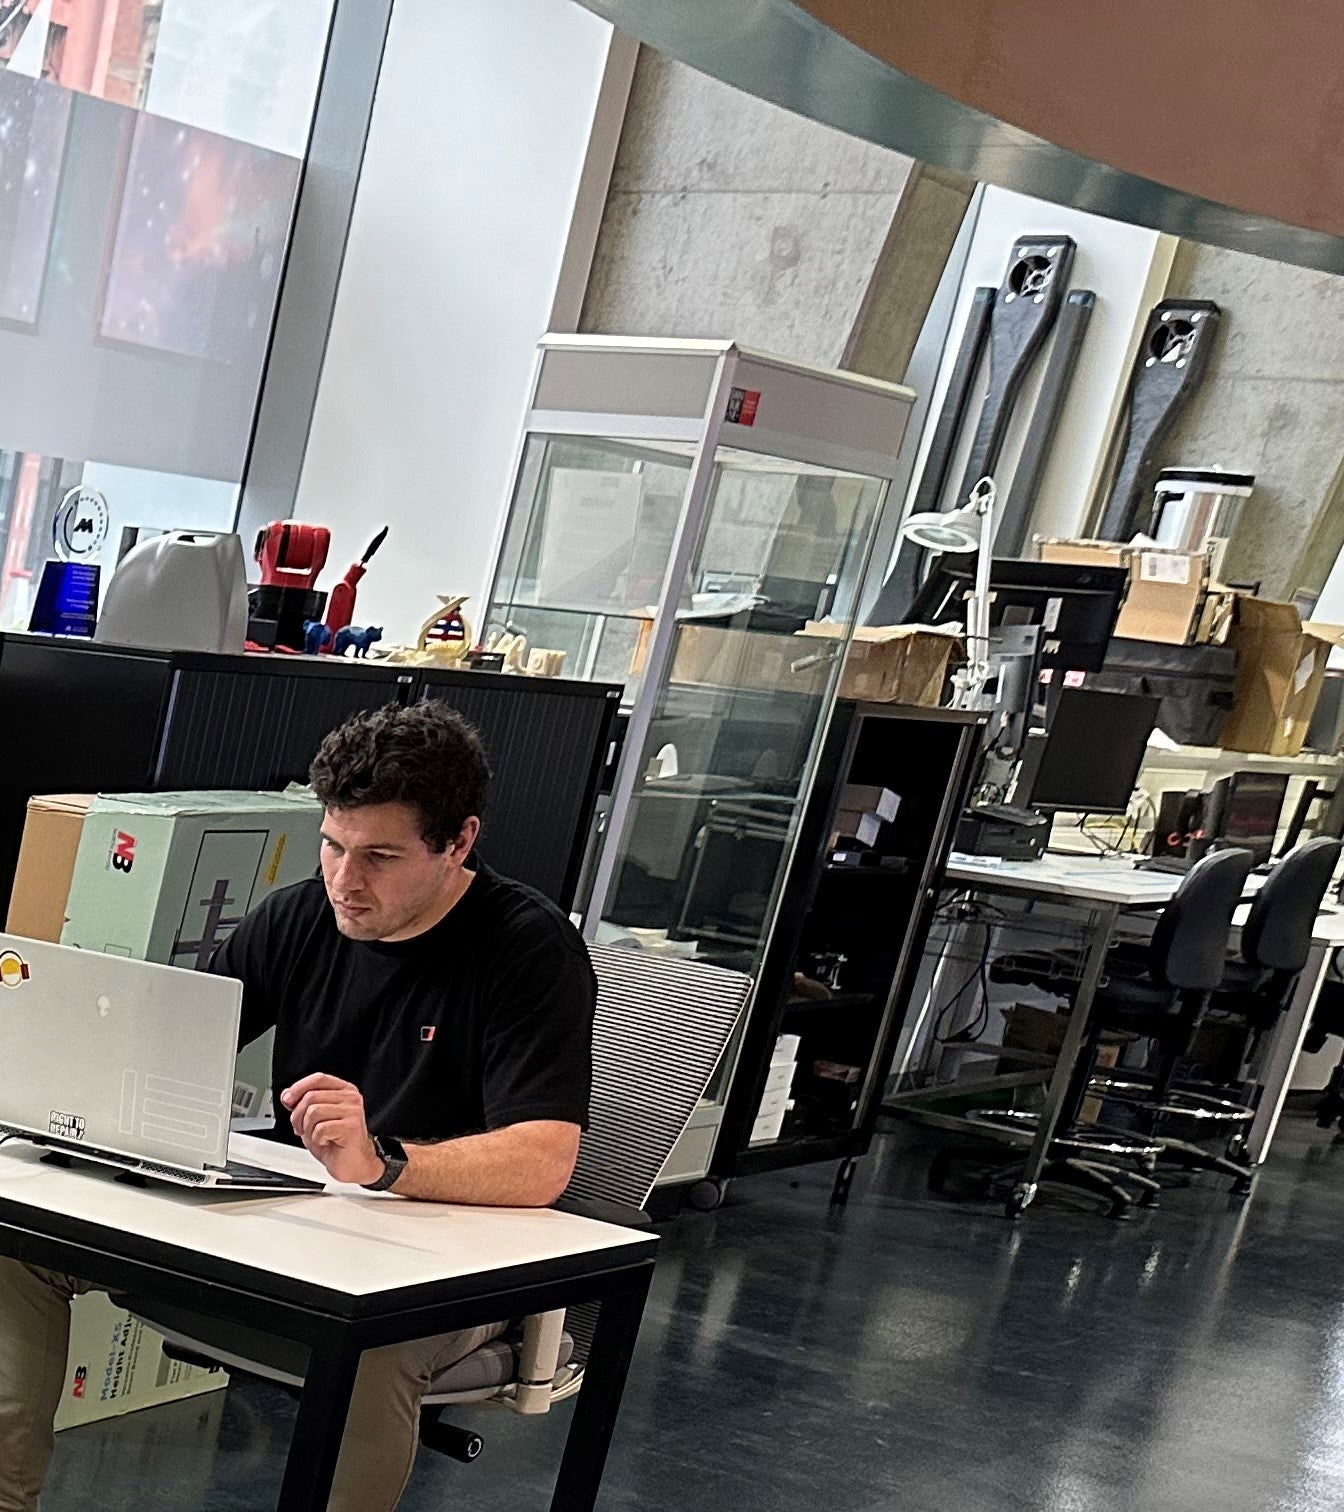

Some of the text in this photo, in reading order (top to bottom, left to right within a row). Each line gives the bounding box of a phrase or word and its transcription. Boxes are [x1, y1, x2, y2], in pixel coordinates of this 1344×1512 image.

[112, 830, 137, 874] NB
[72, 1365, 88, 1399] NB
[110, 1351, 124, 1399] Height
